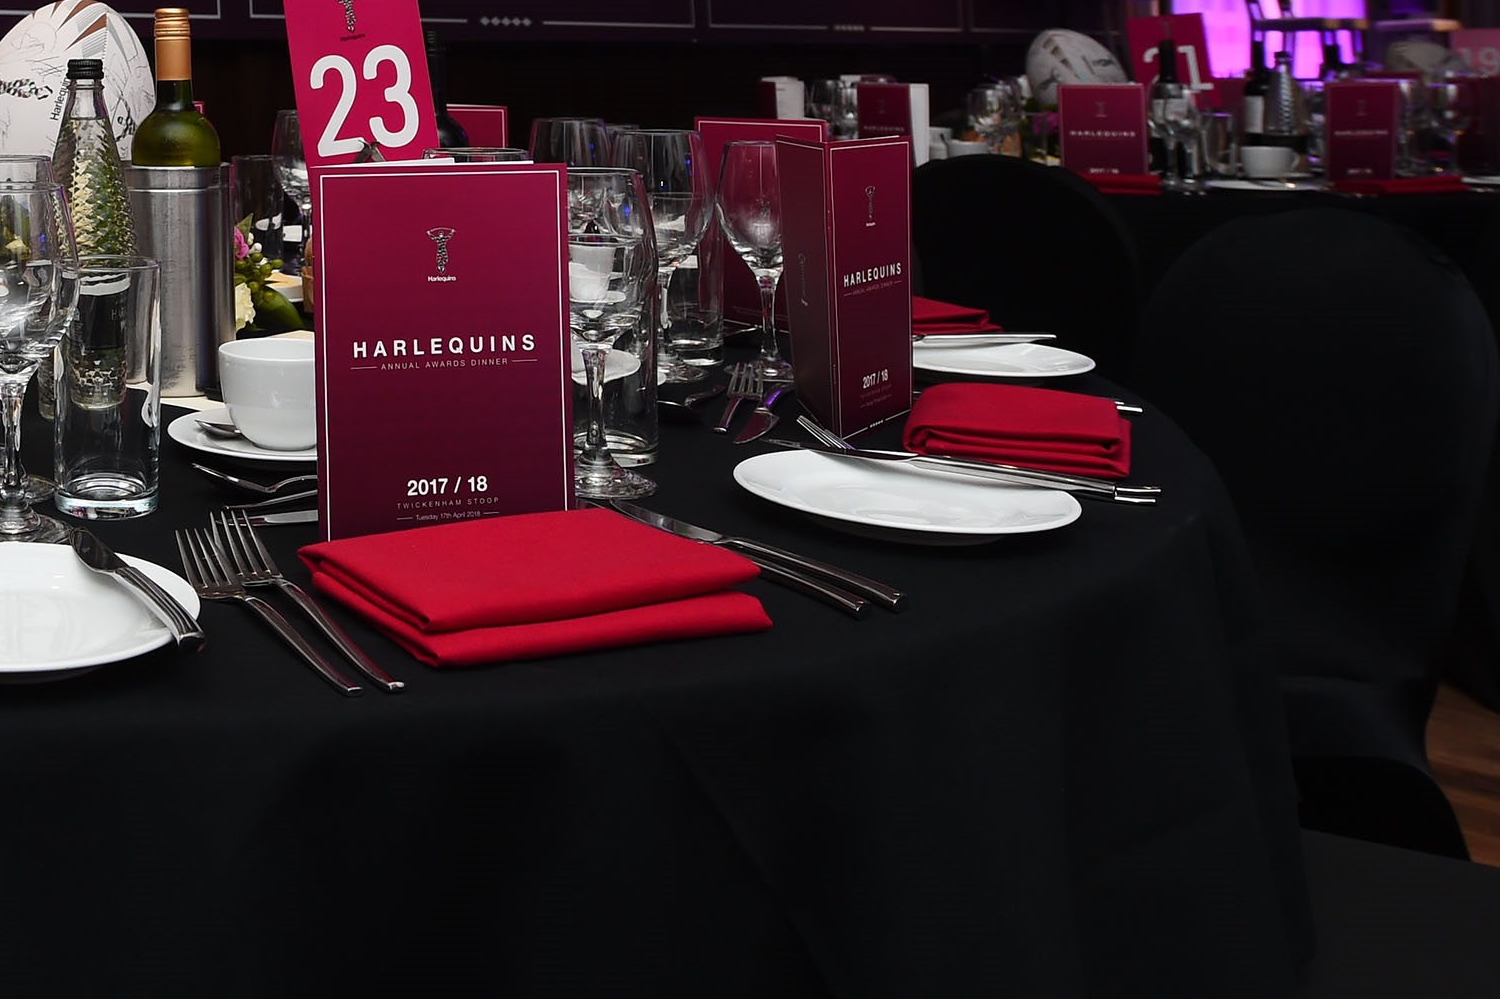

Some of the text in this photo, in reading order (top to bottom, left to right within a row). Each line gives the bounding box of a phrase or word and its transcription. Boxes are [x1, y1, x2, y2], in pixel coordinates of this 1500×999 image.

[49, 77, 71, 121] Harlequin
[309, 44, 420, 158] 23
[843, 261, 902, 288] HARLEQUINS
[353, 334, 536, 359] HARLEQUINS
[380, 357, 508, 371] ANNUAL AWARDS DINNER
[862, 373, 876, 389] 2017
[406, 475, 488, 497] 2017 / 18
[396, 496, 499, 510] TWICKENHAM STOOP
[415, 510, 481, 522] Tuesday 17th April 2018
